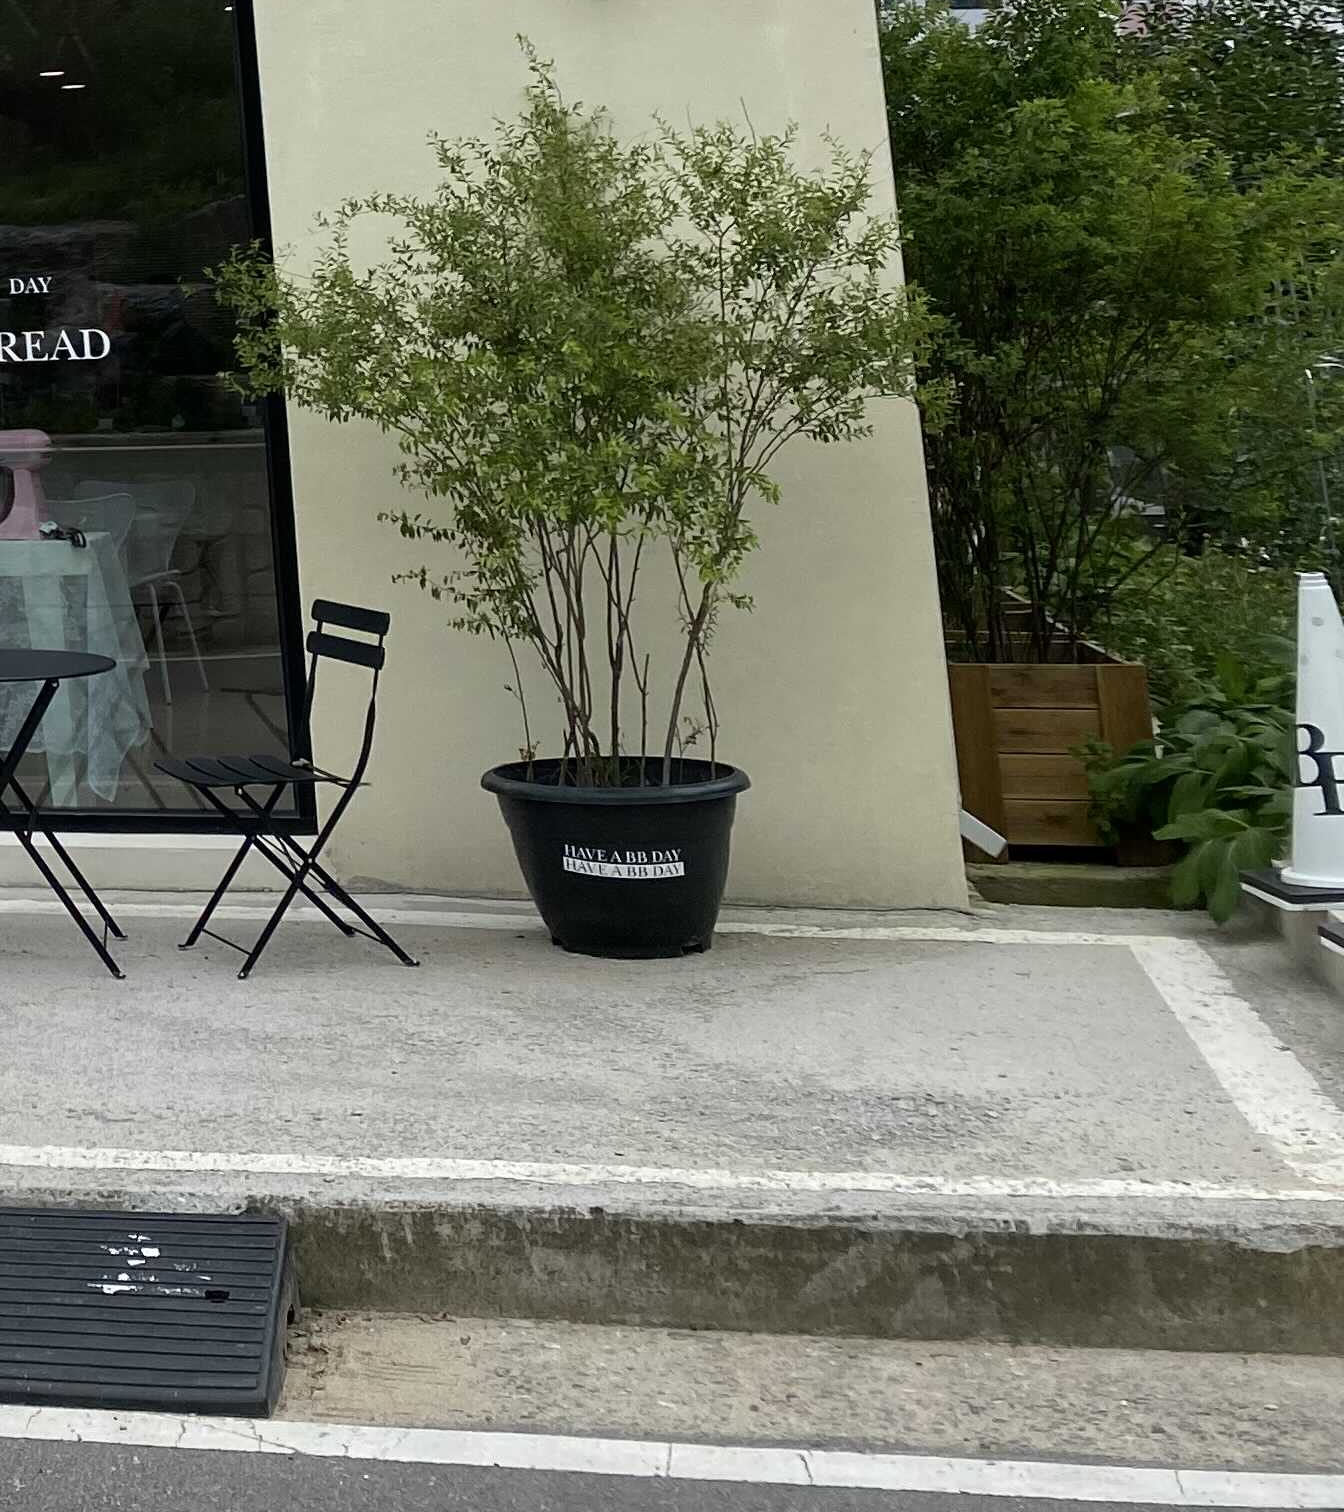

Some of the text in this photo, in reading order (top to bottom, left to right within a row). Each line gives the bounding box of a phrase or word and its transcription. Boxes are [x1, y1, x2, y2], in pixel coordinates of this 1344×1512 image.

[9, 276, 52, 295] DAY
[564, 843, 681, 863] HAVE A BB DAY
[565, 858, 683, 877] HAVE A BB DAY
